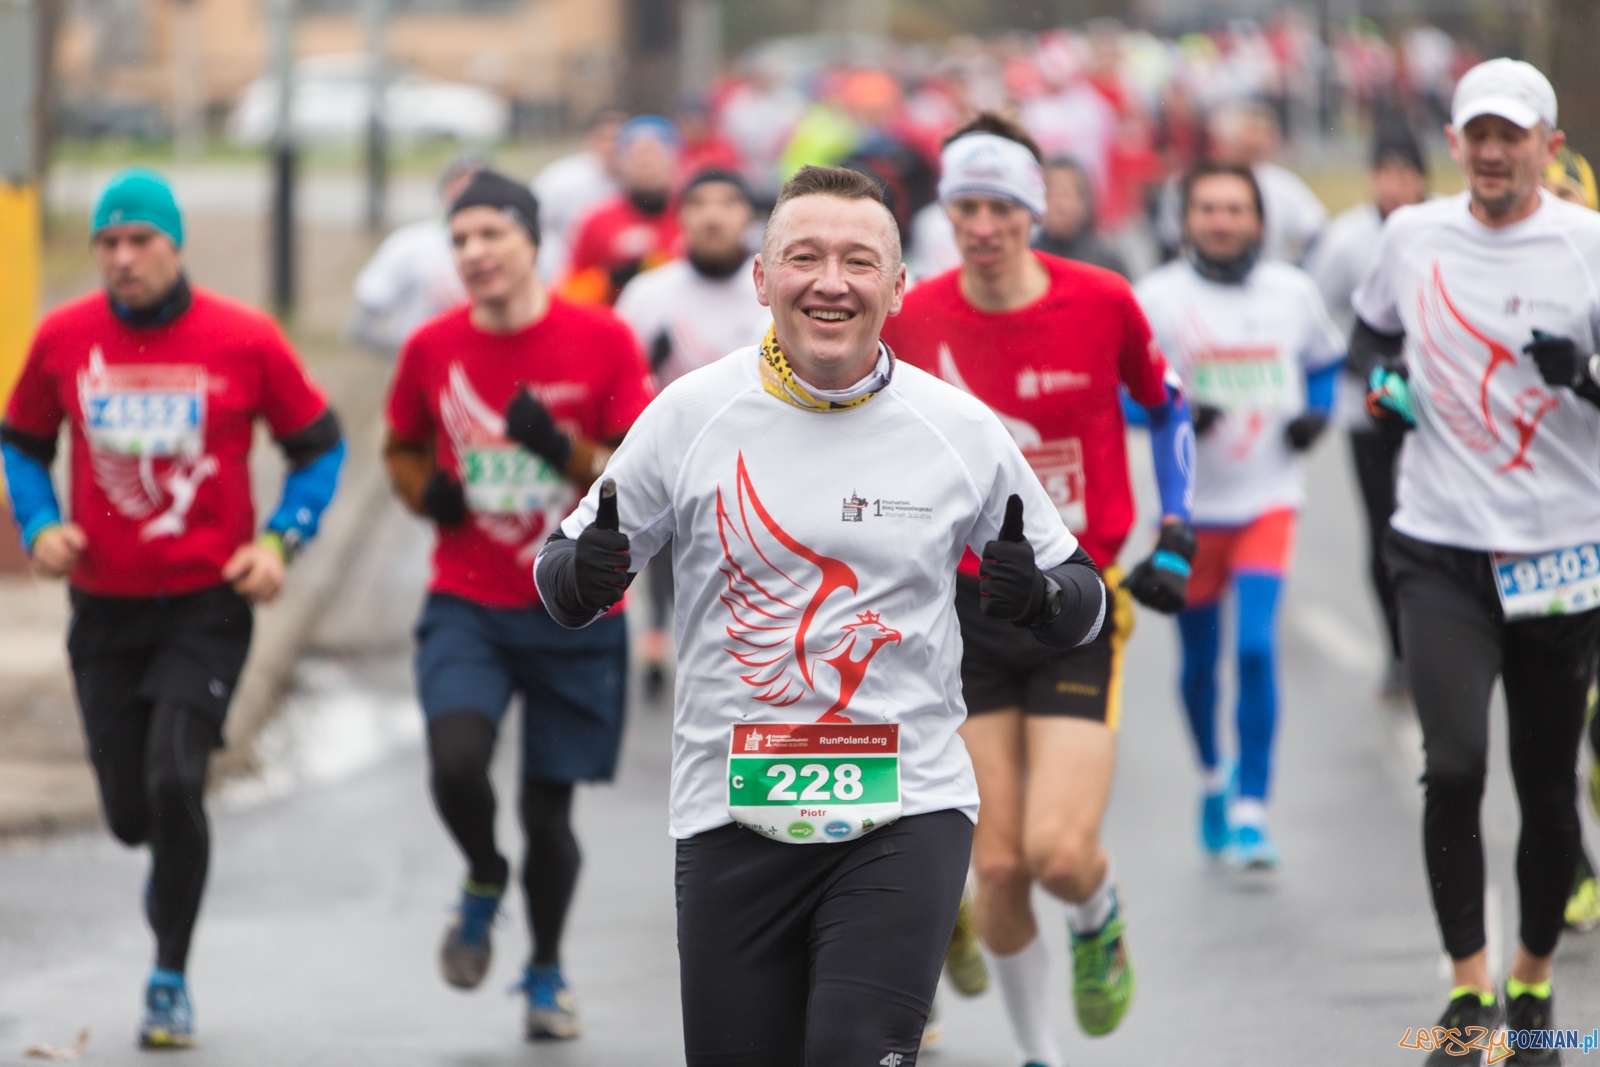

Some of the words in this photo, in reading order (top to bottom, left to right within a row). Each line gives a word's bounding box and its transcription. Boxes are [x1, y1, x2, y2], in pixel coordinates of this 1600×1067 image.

[873, 499, 883, 517] 1
[1512, 544, 1599, 593] 9503
[819, 736, 887, 746] RunPoland.org
[732, 775, 744, 789] C
[766, 763, 864, 801] 228
[800, 809, 826, 817] Piotr
